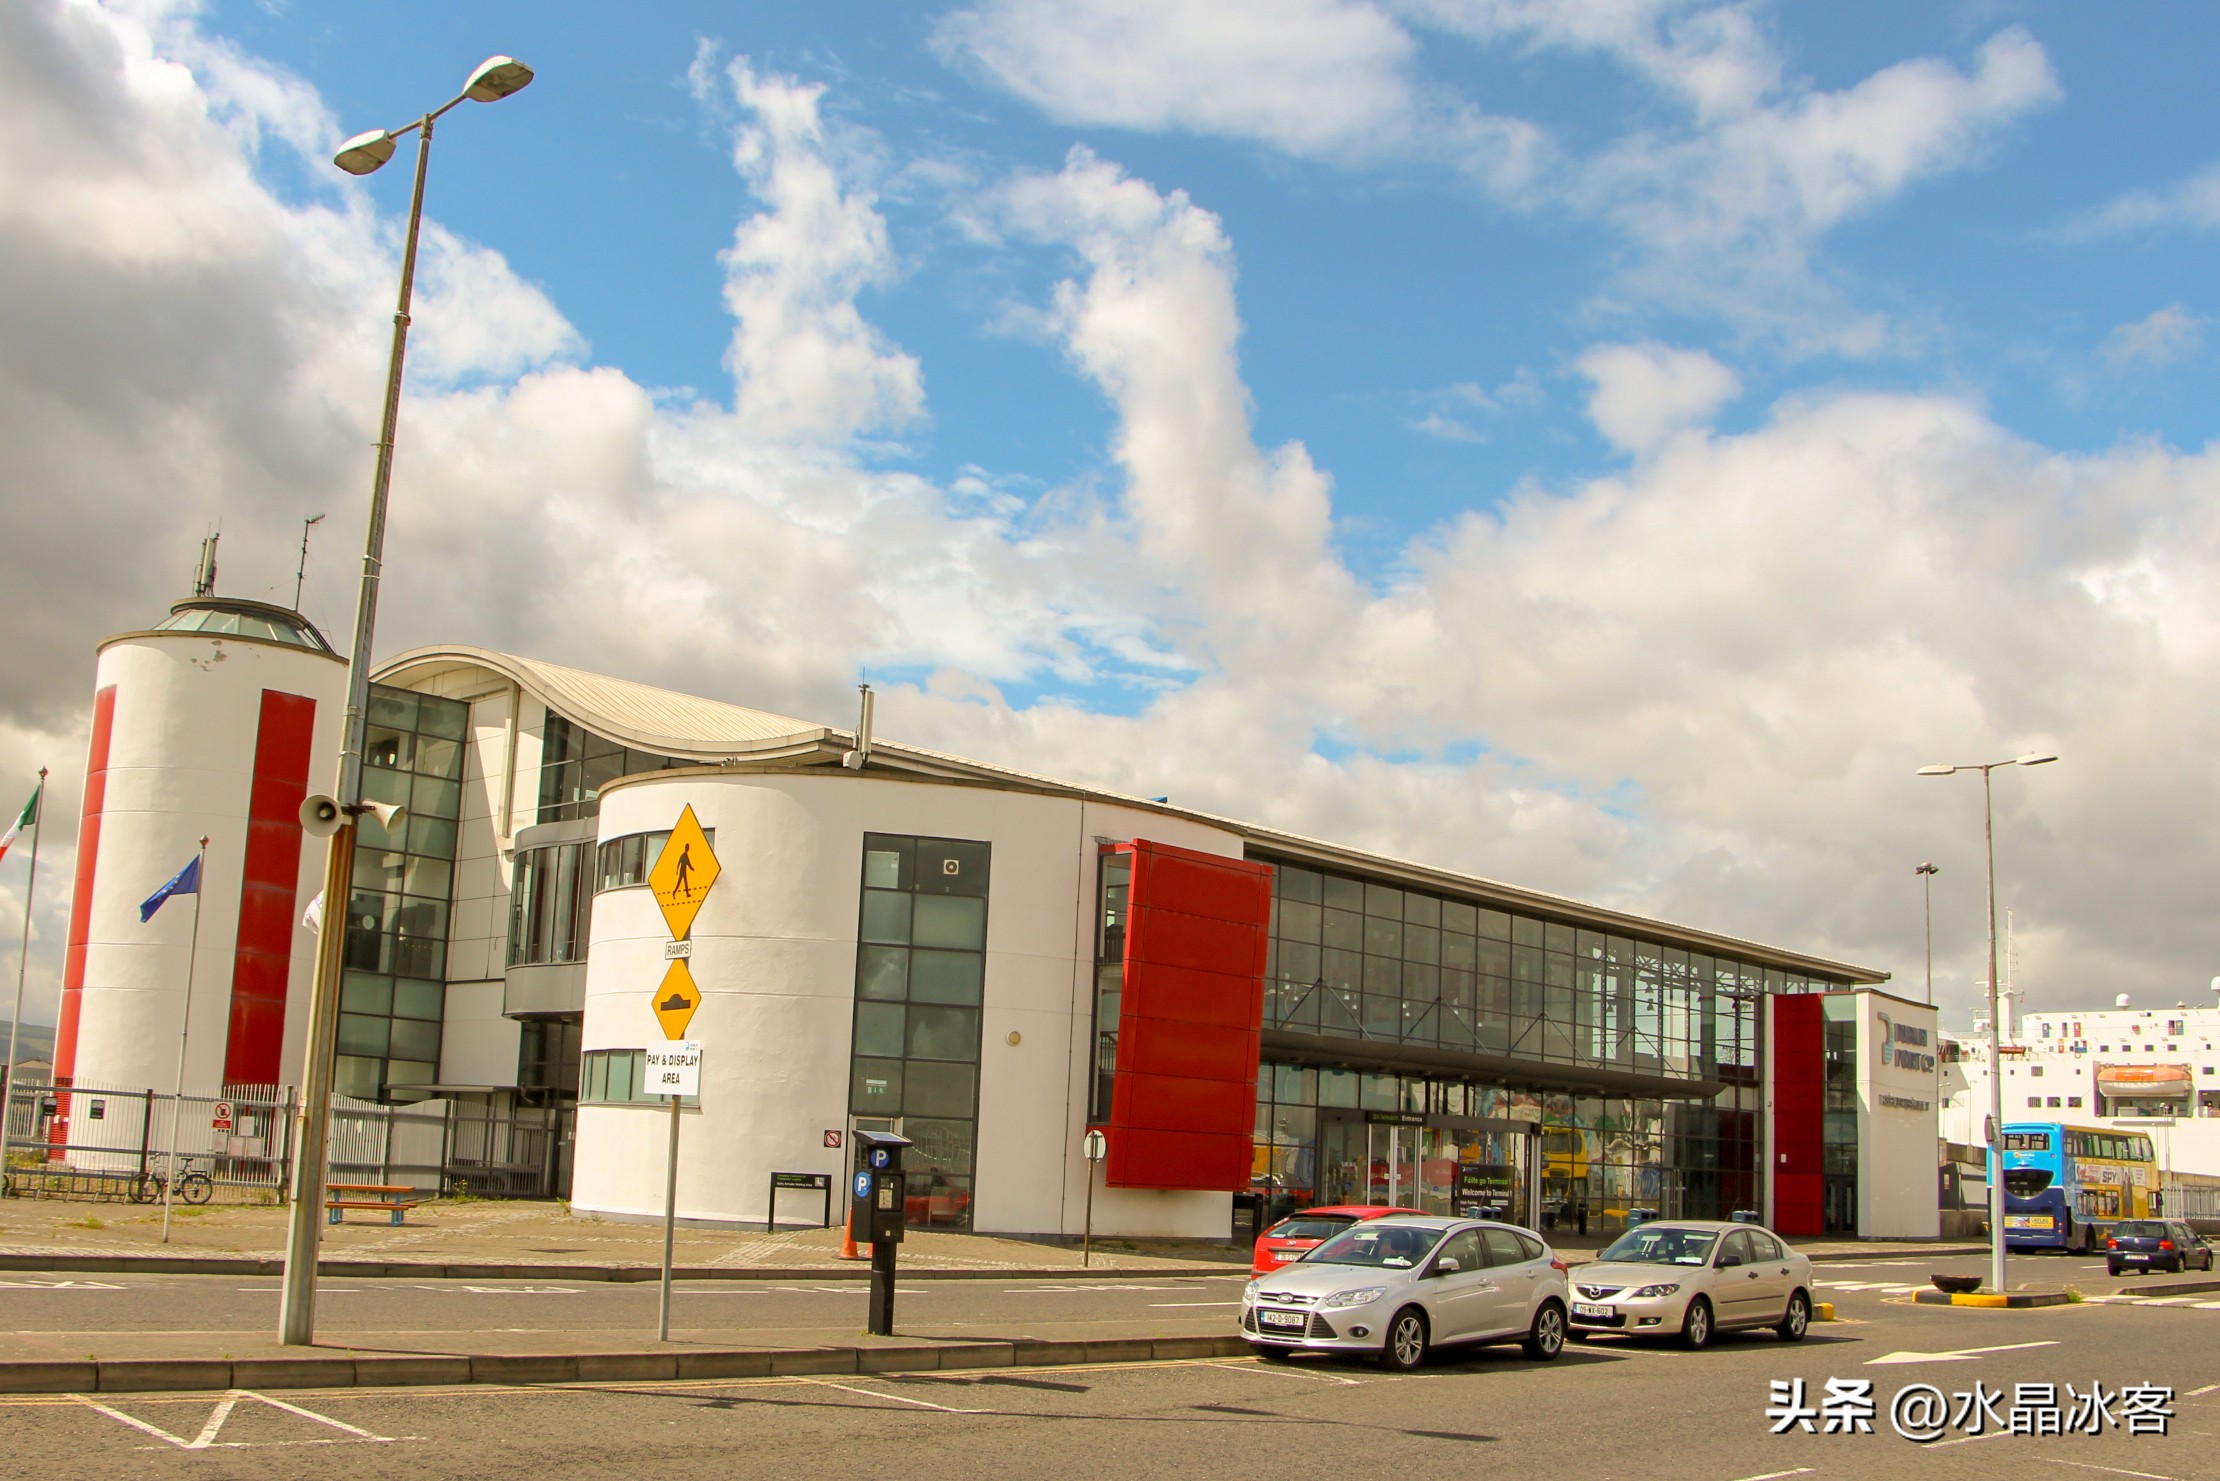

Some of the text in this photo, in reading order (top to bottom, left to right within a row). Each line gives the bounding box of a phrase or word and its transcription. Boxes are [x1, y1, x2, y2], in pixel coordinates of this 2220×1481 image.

[667, 943, 690, 956] RAMPS
[647, 1054, 698, 1067] PAY & DISPLAY
[662, 1072, 680, 1084] AREA
[875, 1150, 887, 1167] P
[2102, 1171, 2117, 1183] SPY
[857, 1176, 867, 1191] P
[1462, 1188, 1485, 1196] Welcome
[1492, 1189, 1509, 1197] Terminal
[1267, 1313, 1300, 1324] 142-D-9087
